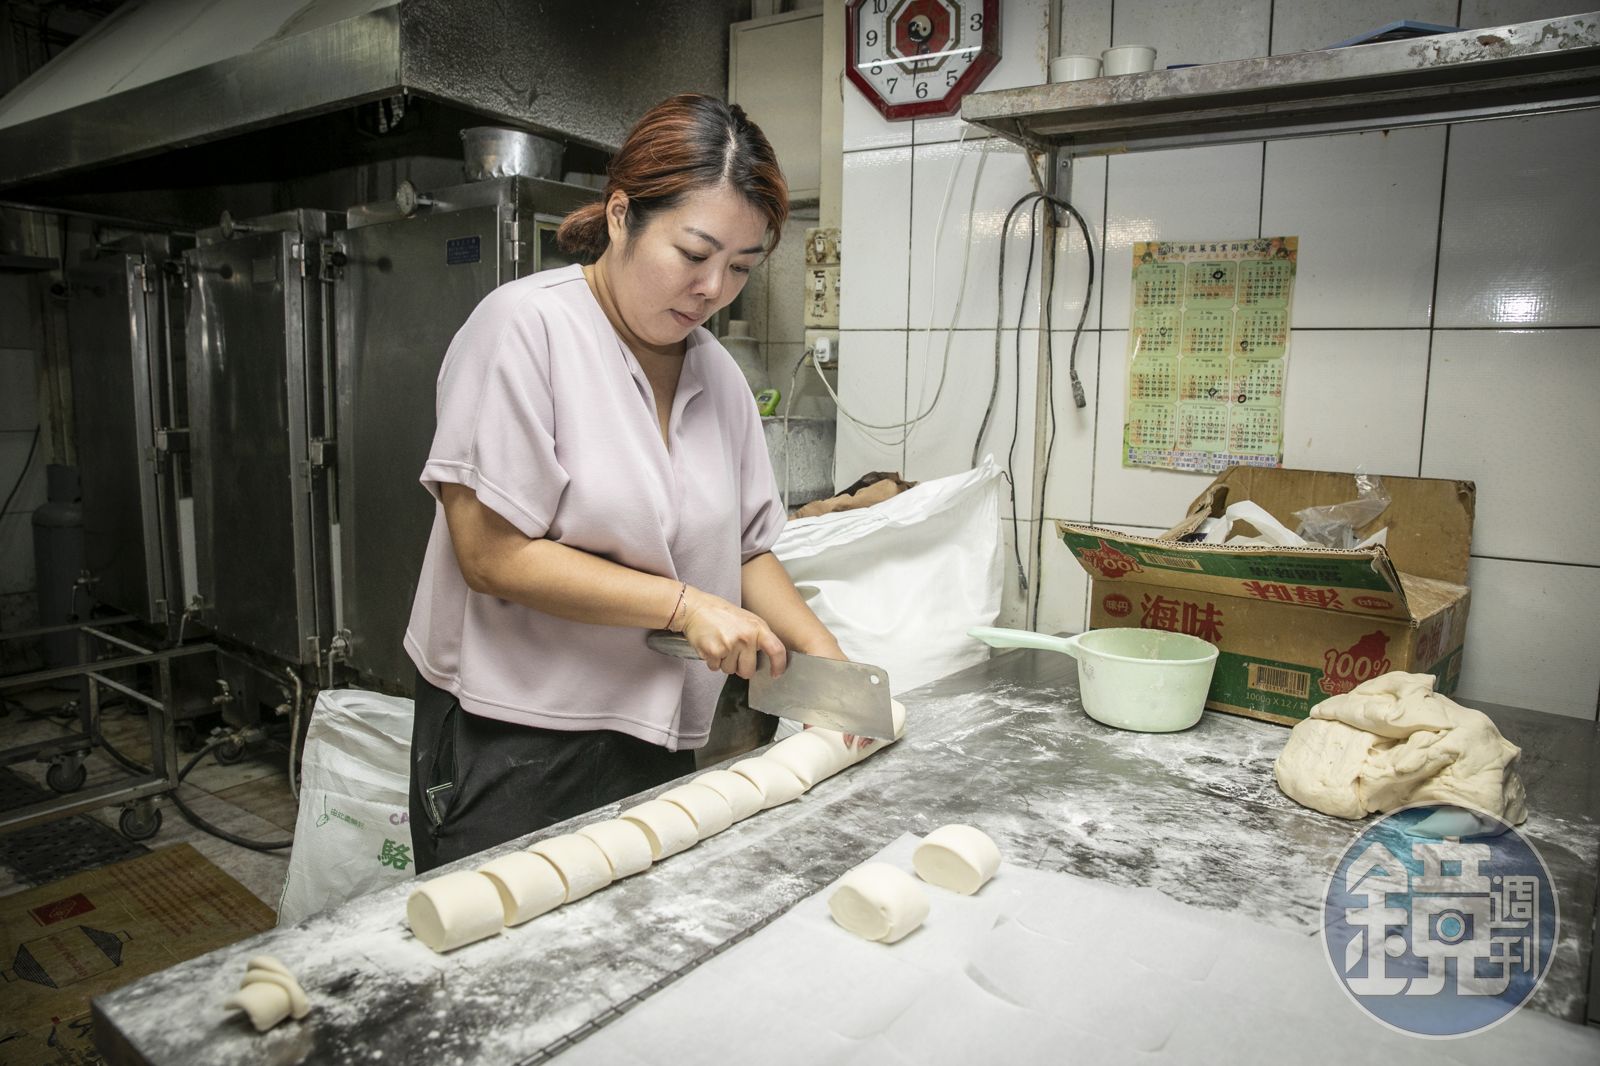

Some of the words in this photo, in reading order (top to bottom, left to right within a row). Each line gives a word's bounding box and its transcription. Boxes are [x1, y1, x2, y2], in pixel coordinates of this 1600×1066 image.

[970, 13, 983, 32] 3
[866, 30, 878, 47] 9
[886, 78, 898, 94] 7
[915, 82, 928, 99] 6
[1140, 592, 1224, 643] 海味
